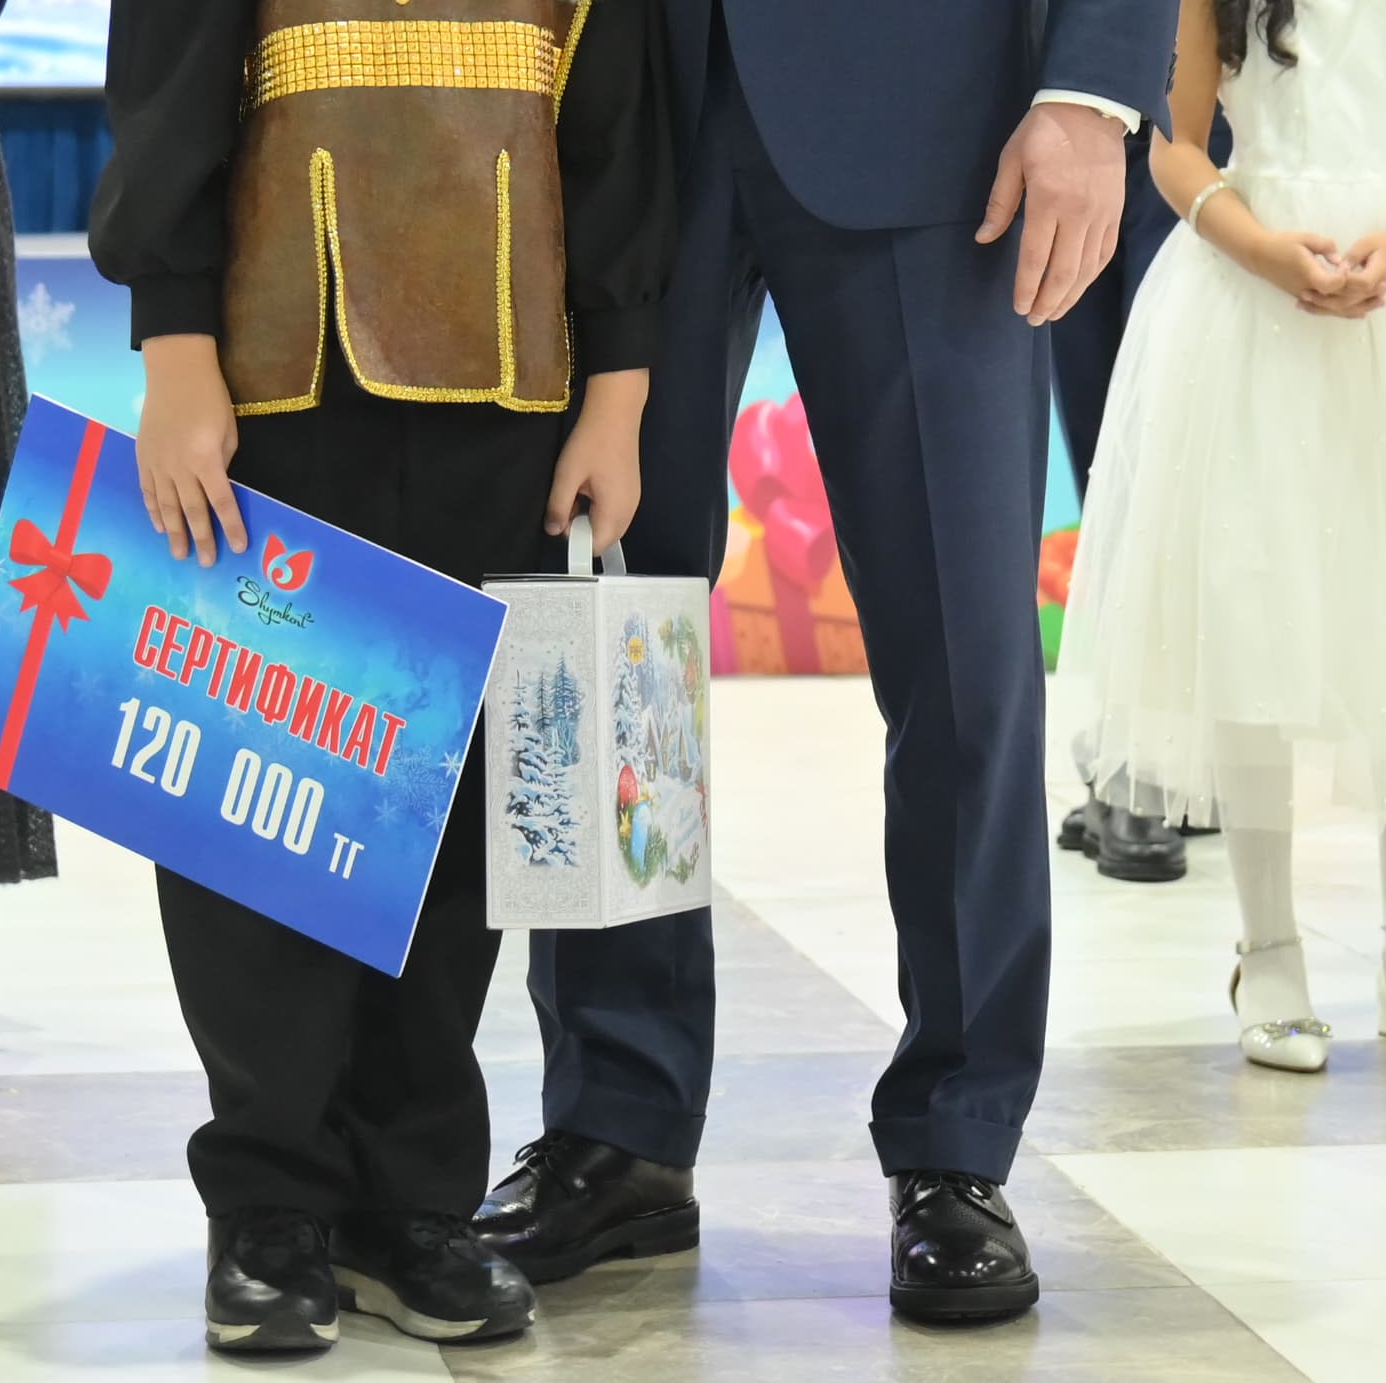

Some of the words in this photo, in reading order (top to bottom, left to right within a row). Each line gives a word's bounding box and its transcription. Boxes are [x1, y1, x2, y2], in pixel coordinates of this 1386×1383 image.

[236, 575, 315, 629] Shymkent
[133, 604, 407, 777] СЕРТИФИКАТ
[111, 697, 202, 798] 120
[220, 747, 325, 855] 000
